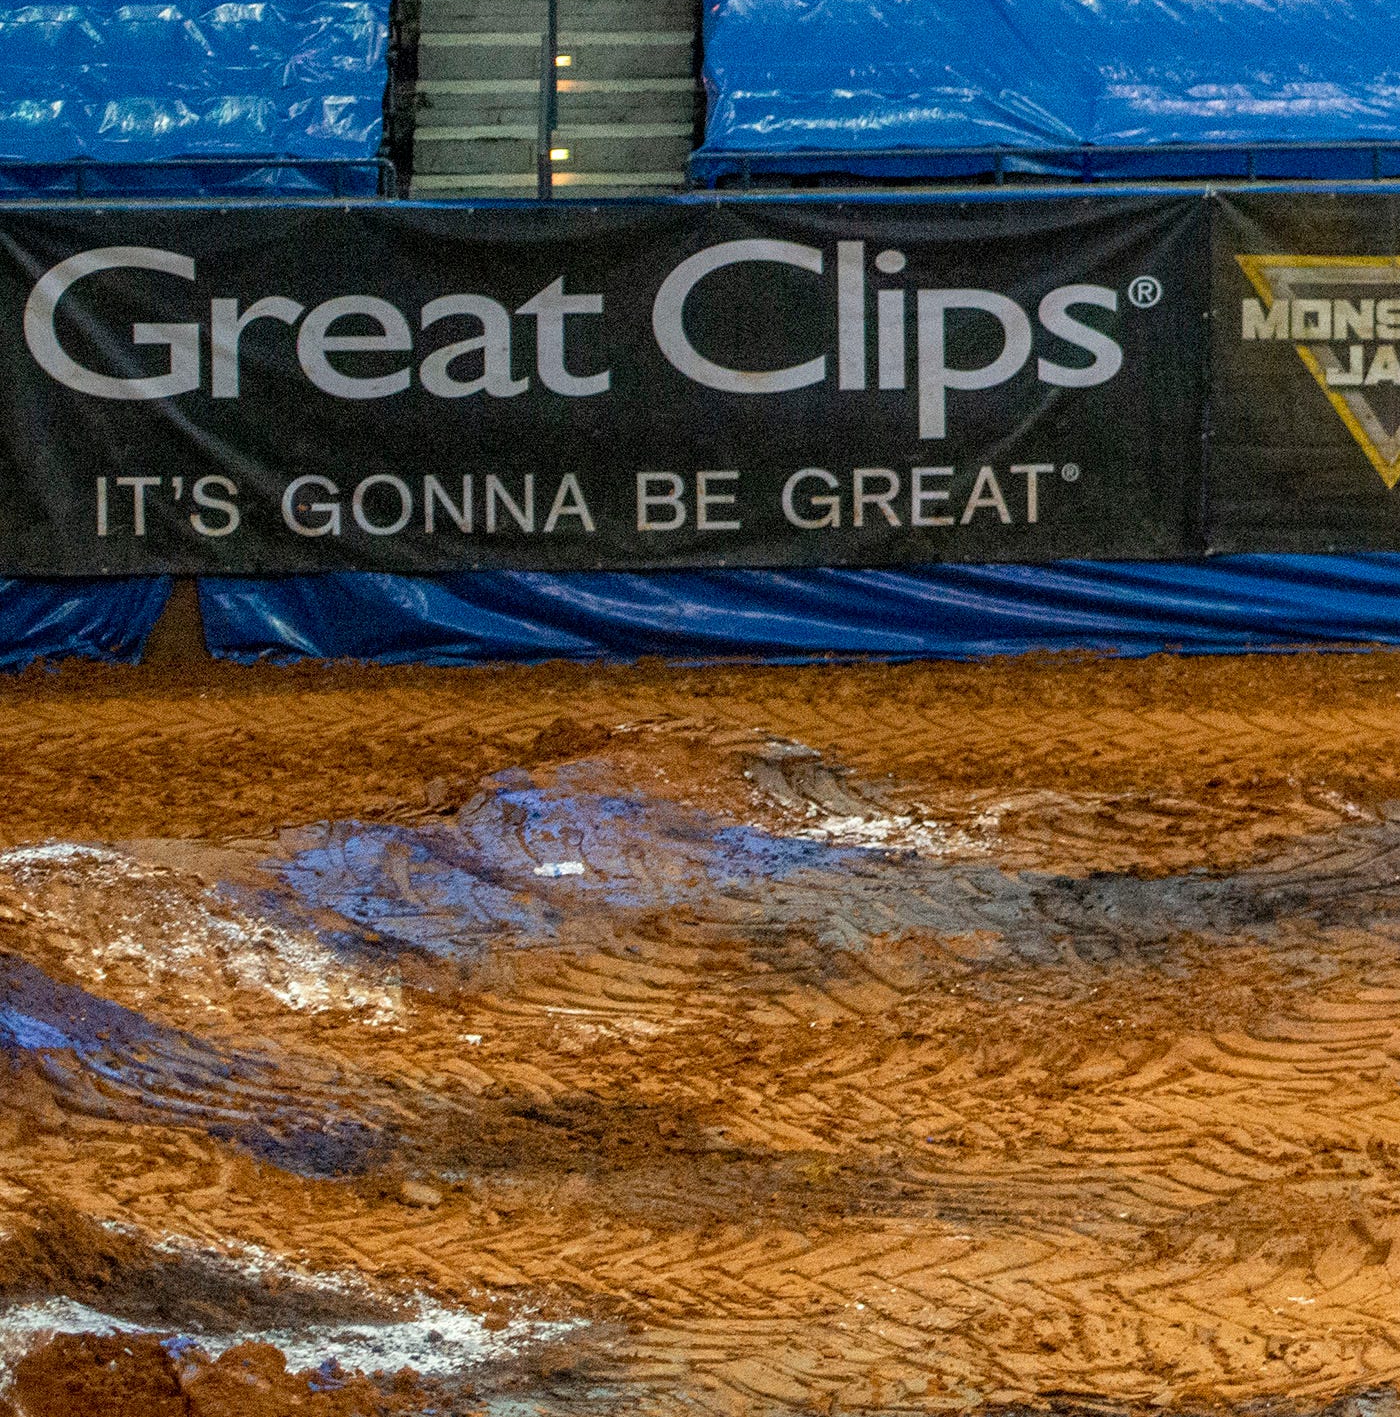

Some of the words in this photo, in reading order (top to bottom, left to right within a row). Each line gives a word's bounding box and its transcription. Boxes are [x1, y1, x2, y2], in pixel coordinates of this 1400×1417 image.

[23, 245, 611, 401] Great
[96, 475, 242, 537] IT'S
[281, 472, 597, 537] GONNA
[636, 470, 742, 531] BE
